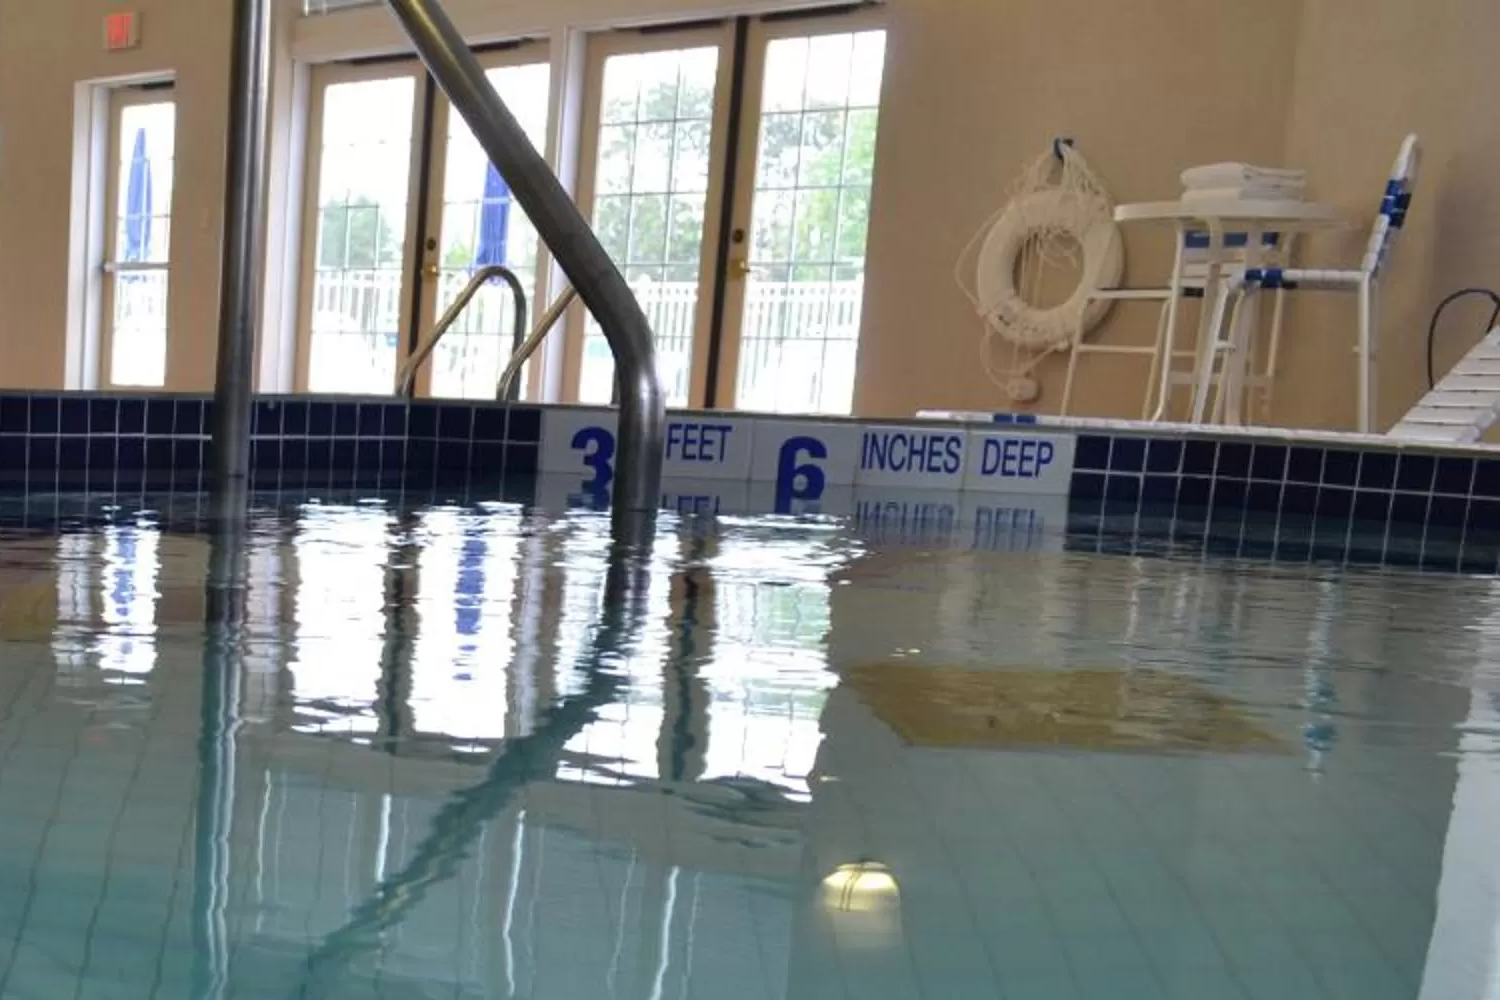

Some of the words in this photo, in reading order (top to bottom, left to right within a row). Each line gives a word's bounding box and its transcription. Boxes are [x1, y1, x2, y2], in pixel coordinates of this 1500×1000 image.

[571, 427, 615, 488] 3
[666, 423, 733, 463] FEET
[775, 436, 828, 498] 6
[861, 432, 962, 474] INCHES
[981, 438, 1054, 478] DEEP
